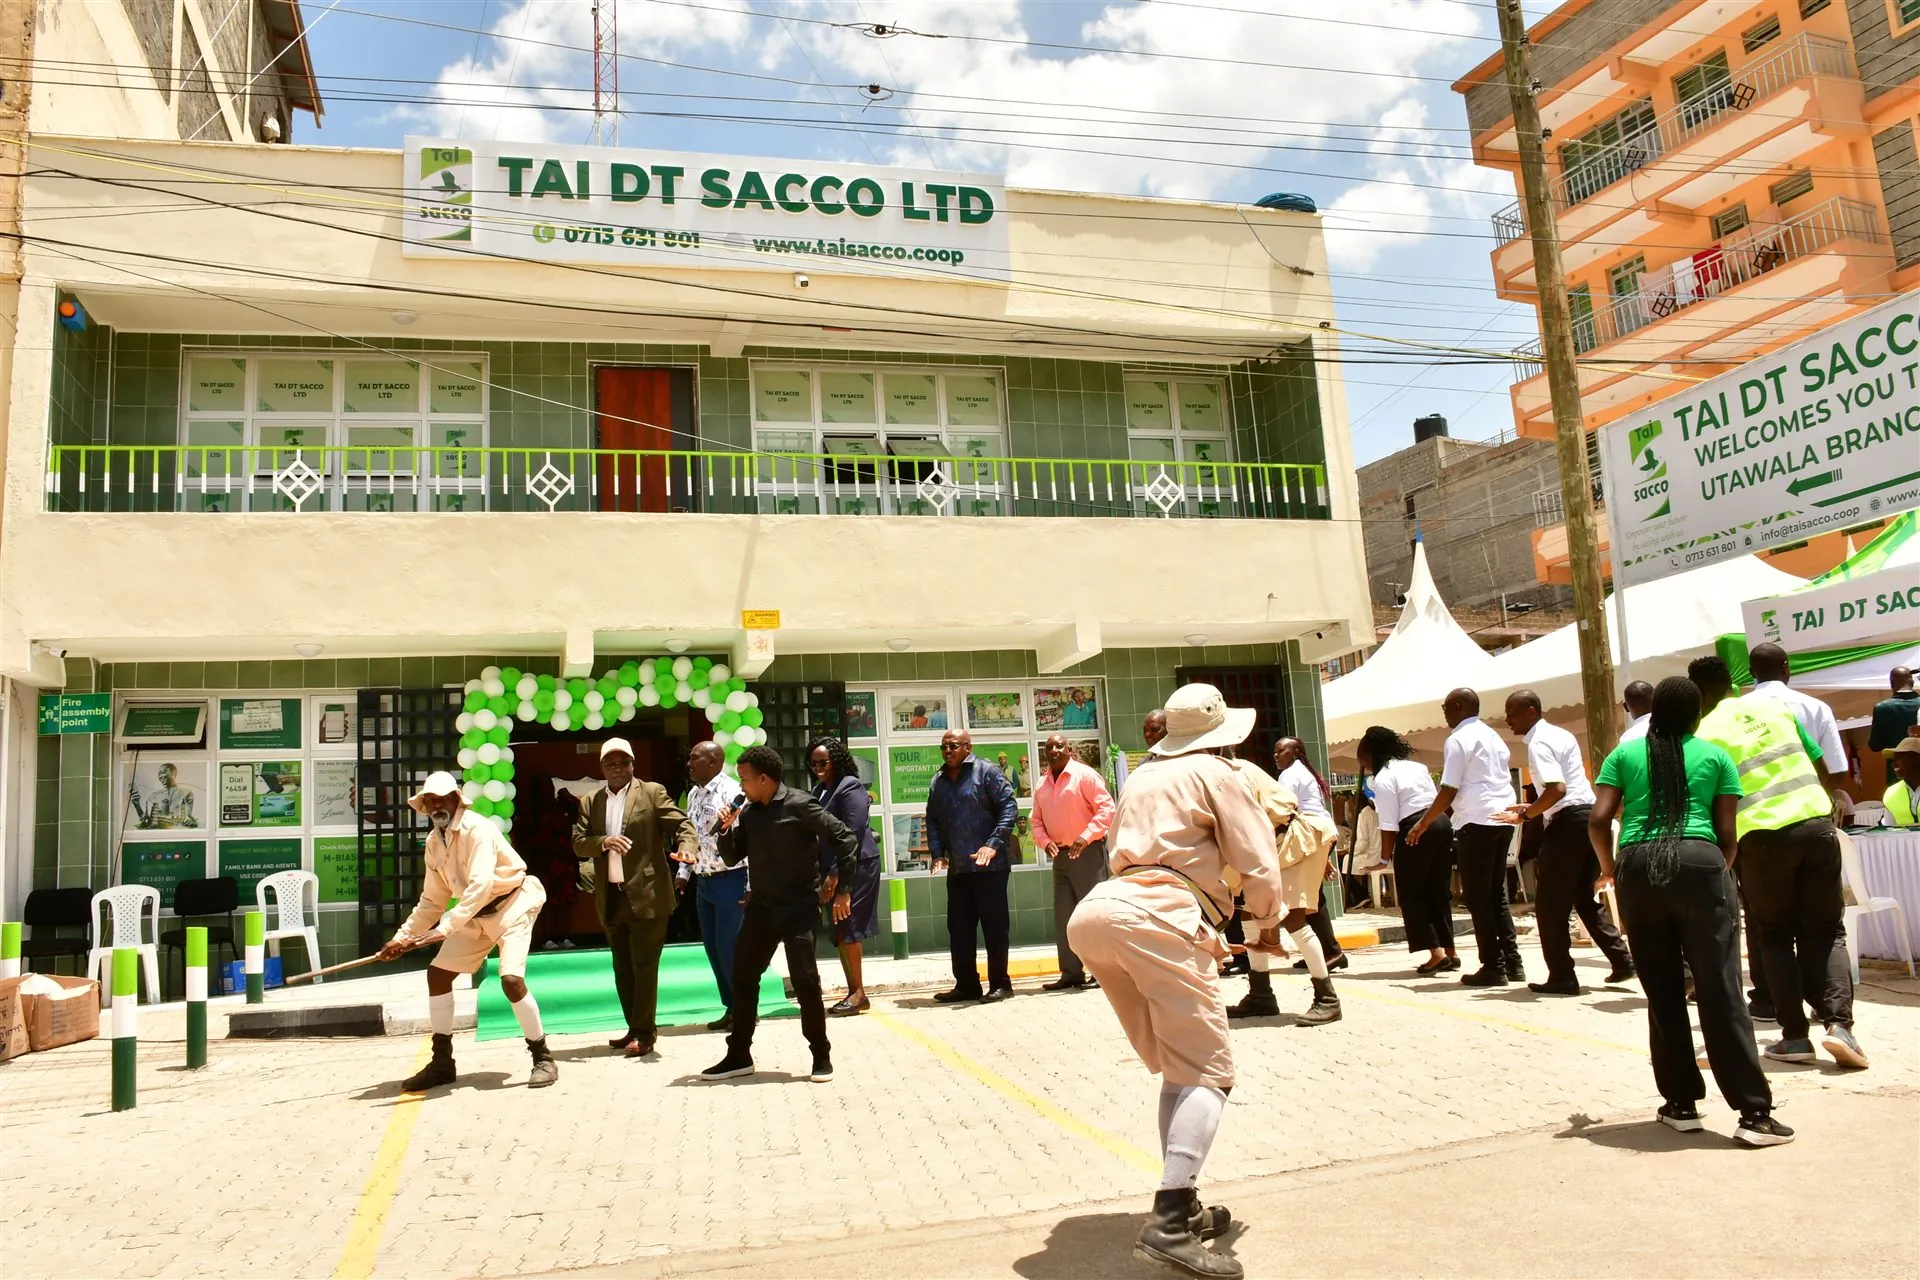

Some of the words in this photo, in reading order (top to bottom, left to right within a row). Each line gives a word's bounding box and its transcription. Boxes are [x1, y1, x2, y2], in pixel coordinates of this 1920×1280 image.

[431, 146, 459, 162] Tai
[498, 157, 590, 200] TAI
[611, 163, 684, 205] DT
[700, 168, 885, 217] SACCO
[901, 182, 994, 225] LTD
[420, 206, 473, 220] sacco
[621, 228, 656, 246] 631
[664, 231, 699, 248] 801
[752, 238, 964, 266] www.taisacco.coop
[1673, 392, 1730, 442] TAI
[1738, 365, 1787, 418] DT
[1800, 314, 1920, 392] SACC
[1694, 399, 1832, 467] WELCOMES
[1836, 372, 1894, 414] YOU
[1902, 363, 1918, 389] T
[1635, 420, 1654, 442] Tai
[1701, 444, 1819, 500] UTAWALA
[1826, 405, 1920, 461] BRANC
[1634, 480, 1668, 502] sacco
[1886, 489, 1920, 506] www.
[1760, 505, 1860, 542] info@taisacco.coop
[1685, 550, 1704, 563] 0713
[1706, 546, 1720, 557] 631
[1721, 541, 1736, 554] 801
[1792, 608, 1824, 632] TAI
[1839, 598, 1867, 622] DT
[1876, 586, 1920, 615] SAC
[62, 698, 82, 706] Fire
[62, 707, 110, 717] assembly
[62, 718, 88, 728] point
[893, 752, 920, 762] YOUR
[323, 854, 358, 862] M-BIAS
